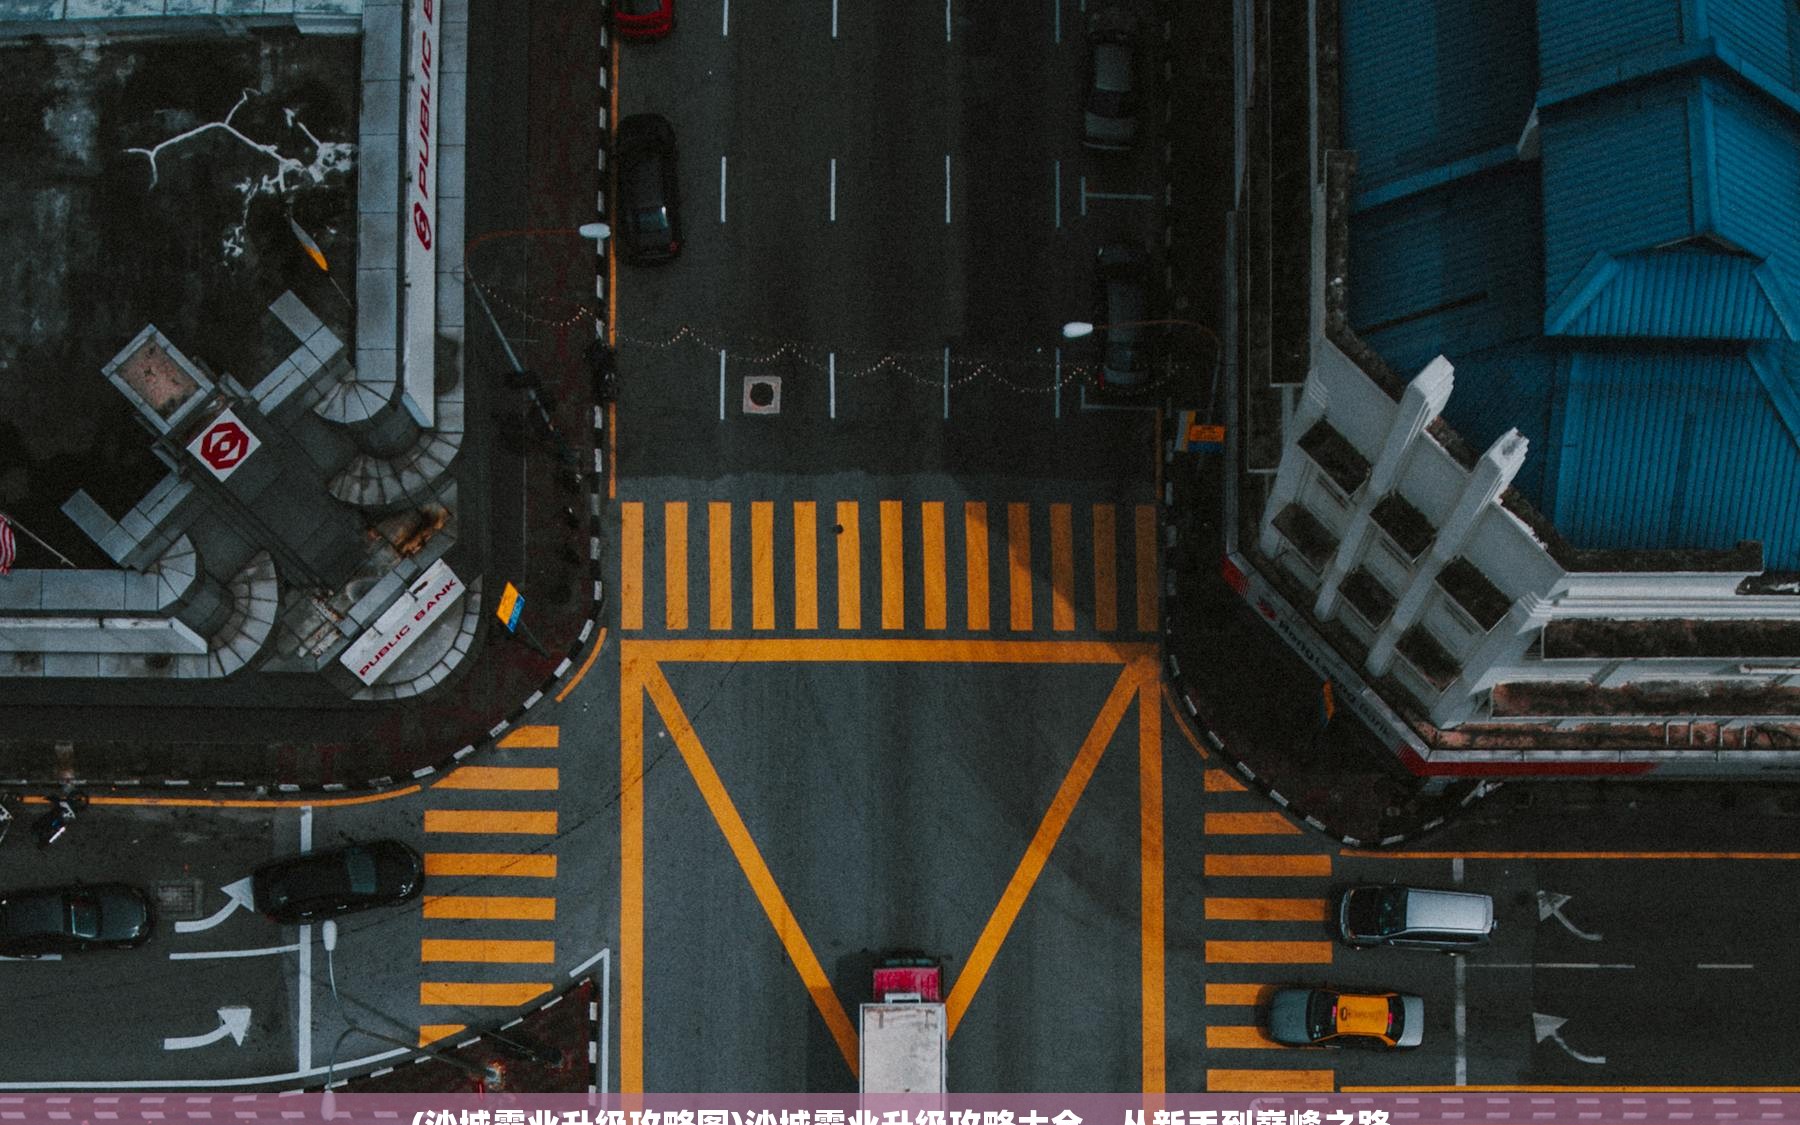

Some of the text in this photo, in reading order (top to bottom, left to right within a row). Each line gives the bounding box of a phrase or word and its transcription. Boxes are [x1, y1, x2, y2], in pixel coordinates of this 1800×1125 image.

[418, 31, 432, 199] PUBLIC
[359, 625, 410, 676] PUBLIC
[414, 579, 457, 621] BANK
